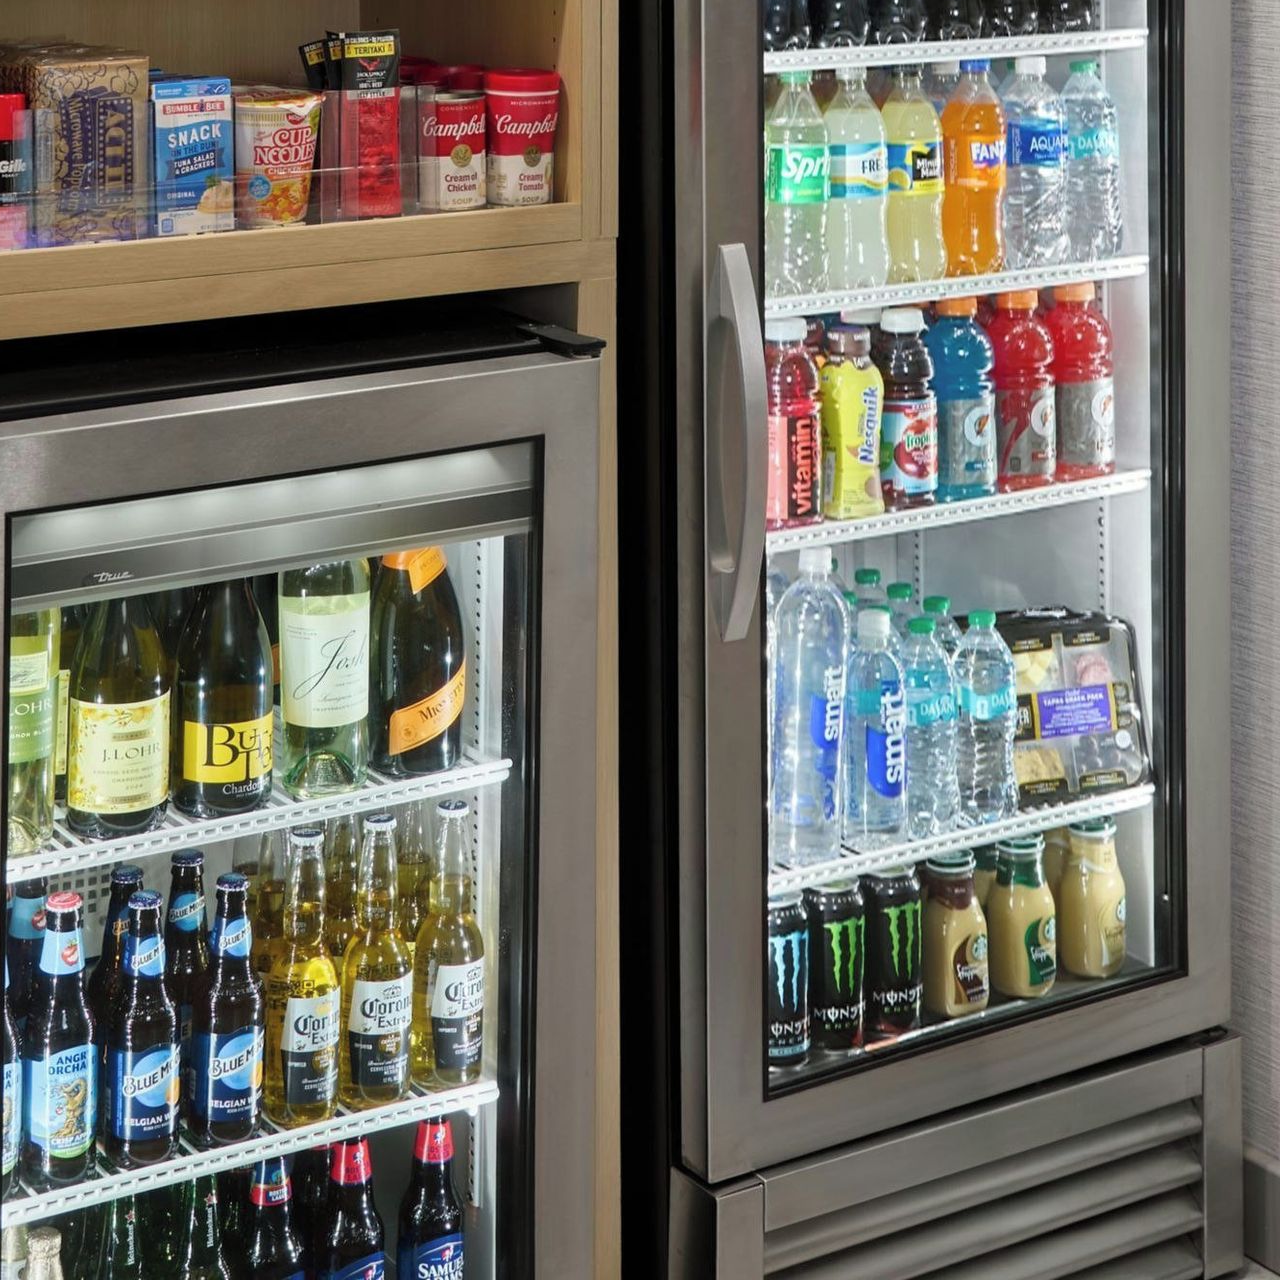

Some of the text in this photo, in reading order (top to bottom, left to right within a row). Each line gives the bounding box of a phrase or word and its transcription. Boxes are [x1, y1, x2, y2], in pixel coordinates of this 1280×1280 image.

[165, 102, 221, 114] BUMBLE BEE
[69, 96, 83, 162] Microwave
[168, 123, 222, 148] SNACK
[274, 130, 311, 146] CUP
[174, 153, 214, 167] TUNA SALAD
[181, 159, 215, 174] CRACKERS
[445, 174, 468, 182] Cream
[448, 184, 476, 192] Chicken
[519, 183, 544, 191] Tomato
[860, 387, 878, 463] Nesquik
[792, 419, 811, 515] vitamin
[94, 571, 133, 582] True
[293, 629, 366, 700] Josh
[824, 666, 841, 741] smart
[881, 692, 903, 783] smart
[220, 934, 240, 948] BLUE
[132, 950, 154, 968] BLUE
[378, 1015, 406, 1029] Extra
[210, 1056, 244, 1077] BLUE
[122, 1070, 159, 1094] BLUE
[210, 1100, 248, 1109] BELGIAN
[125, 1114, 164, 1127] BELGIAN
[207, 1207, 215, 1248] Heineken
[127, 1224, 136, 1265] Heineken
